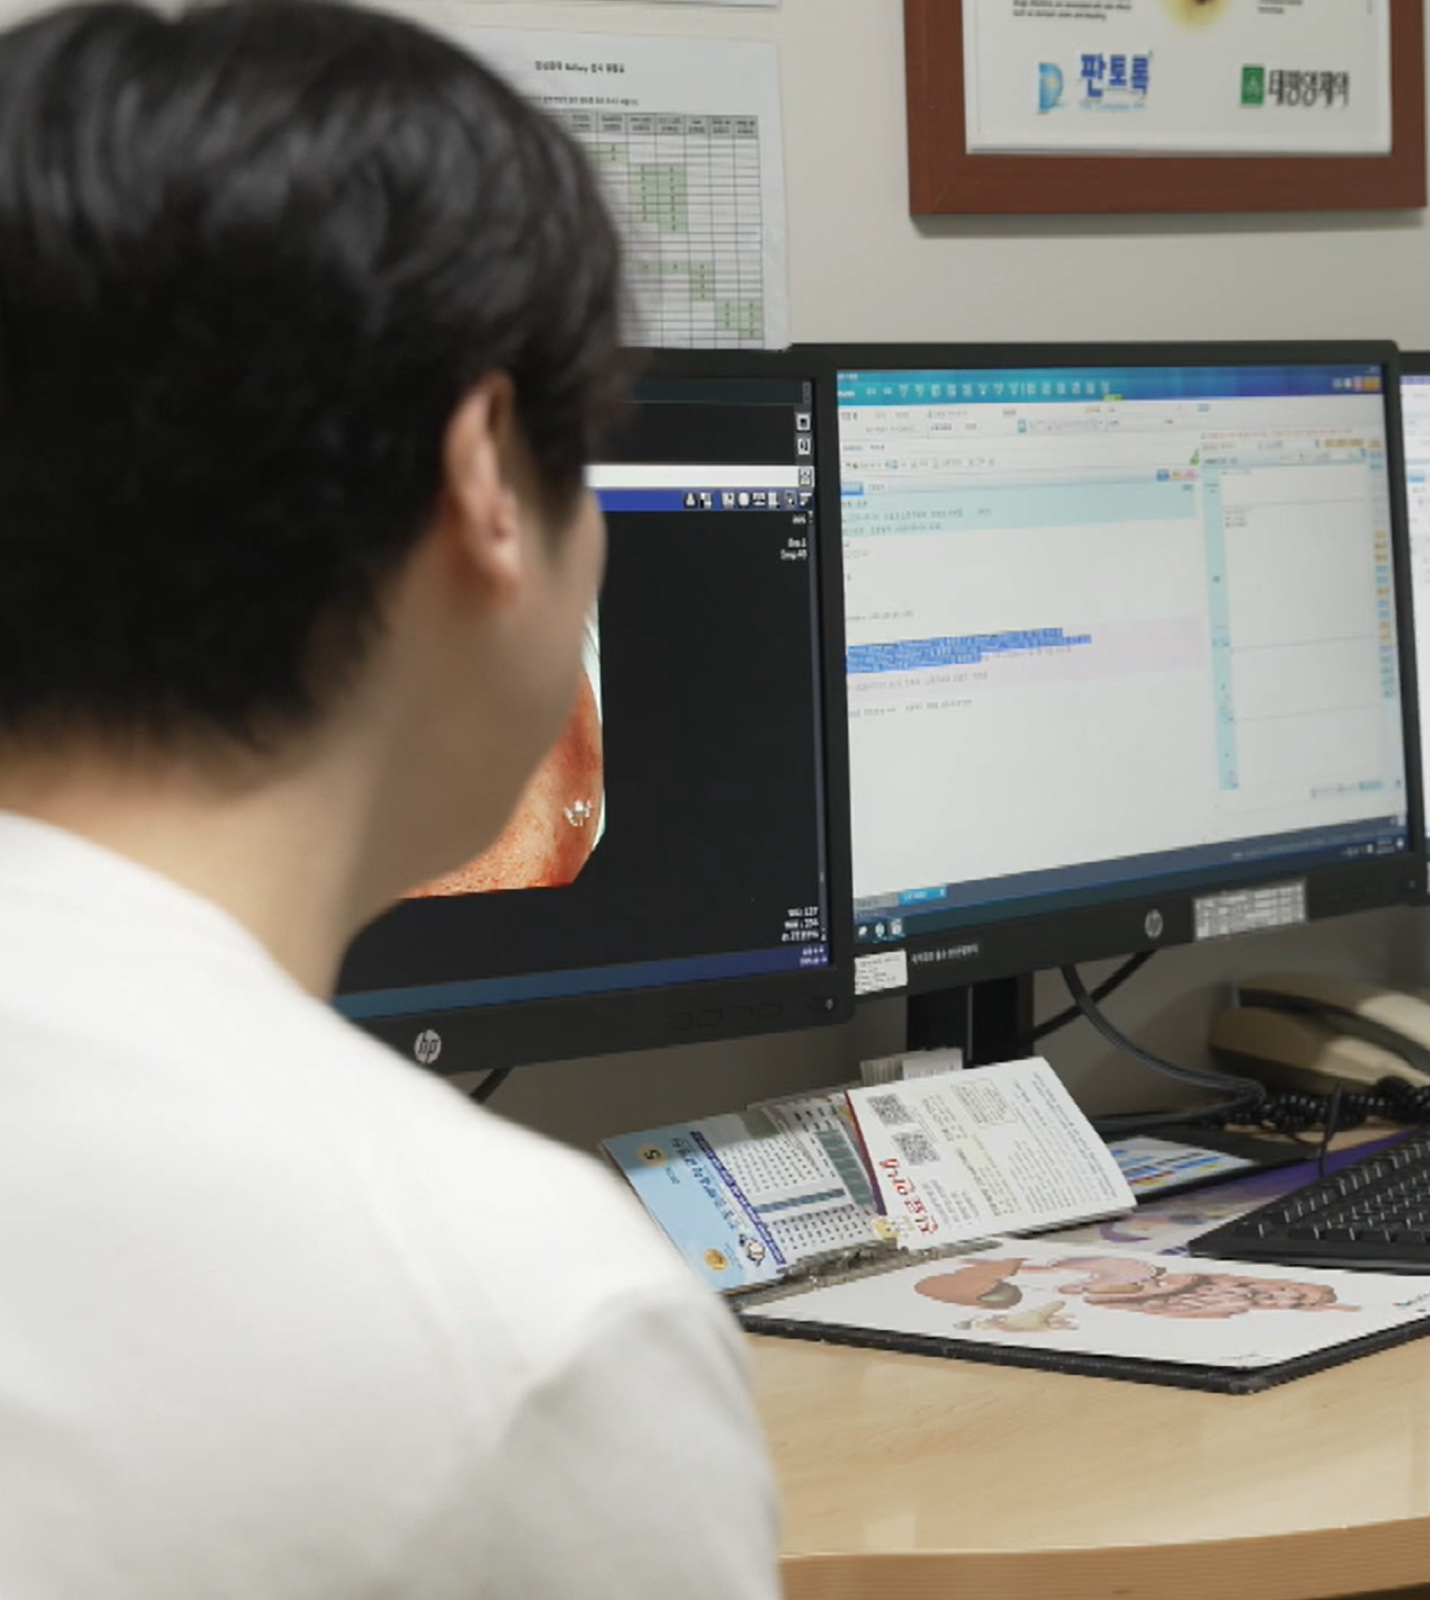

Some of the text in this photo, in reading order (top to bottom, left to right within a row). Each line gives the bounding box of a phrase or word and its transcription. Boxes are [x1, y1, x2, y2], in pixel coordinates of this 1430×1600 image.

[1080, 53, 1149, 98] 판토록
[1268, 69, 1350, 108] 태평양제약
[414, 1029, 441, 1064] hp
